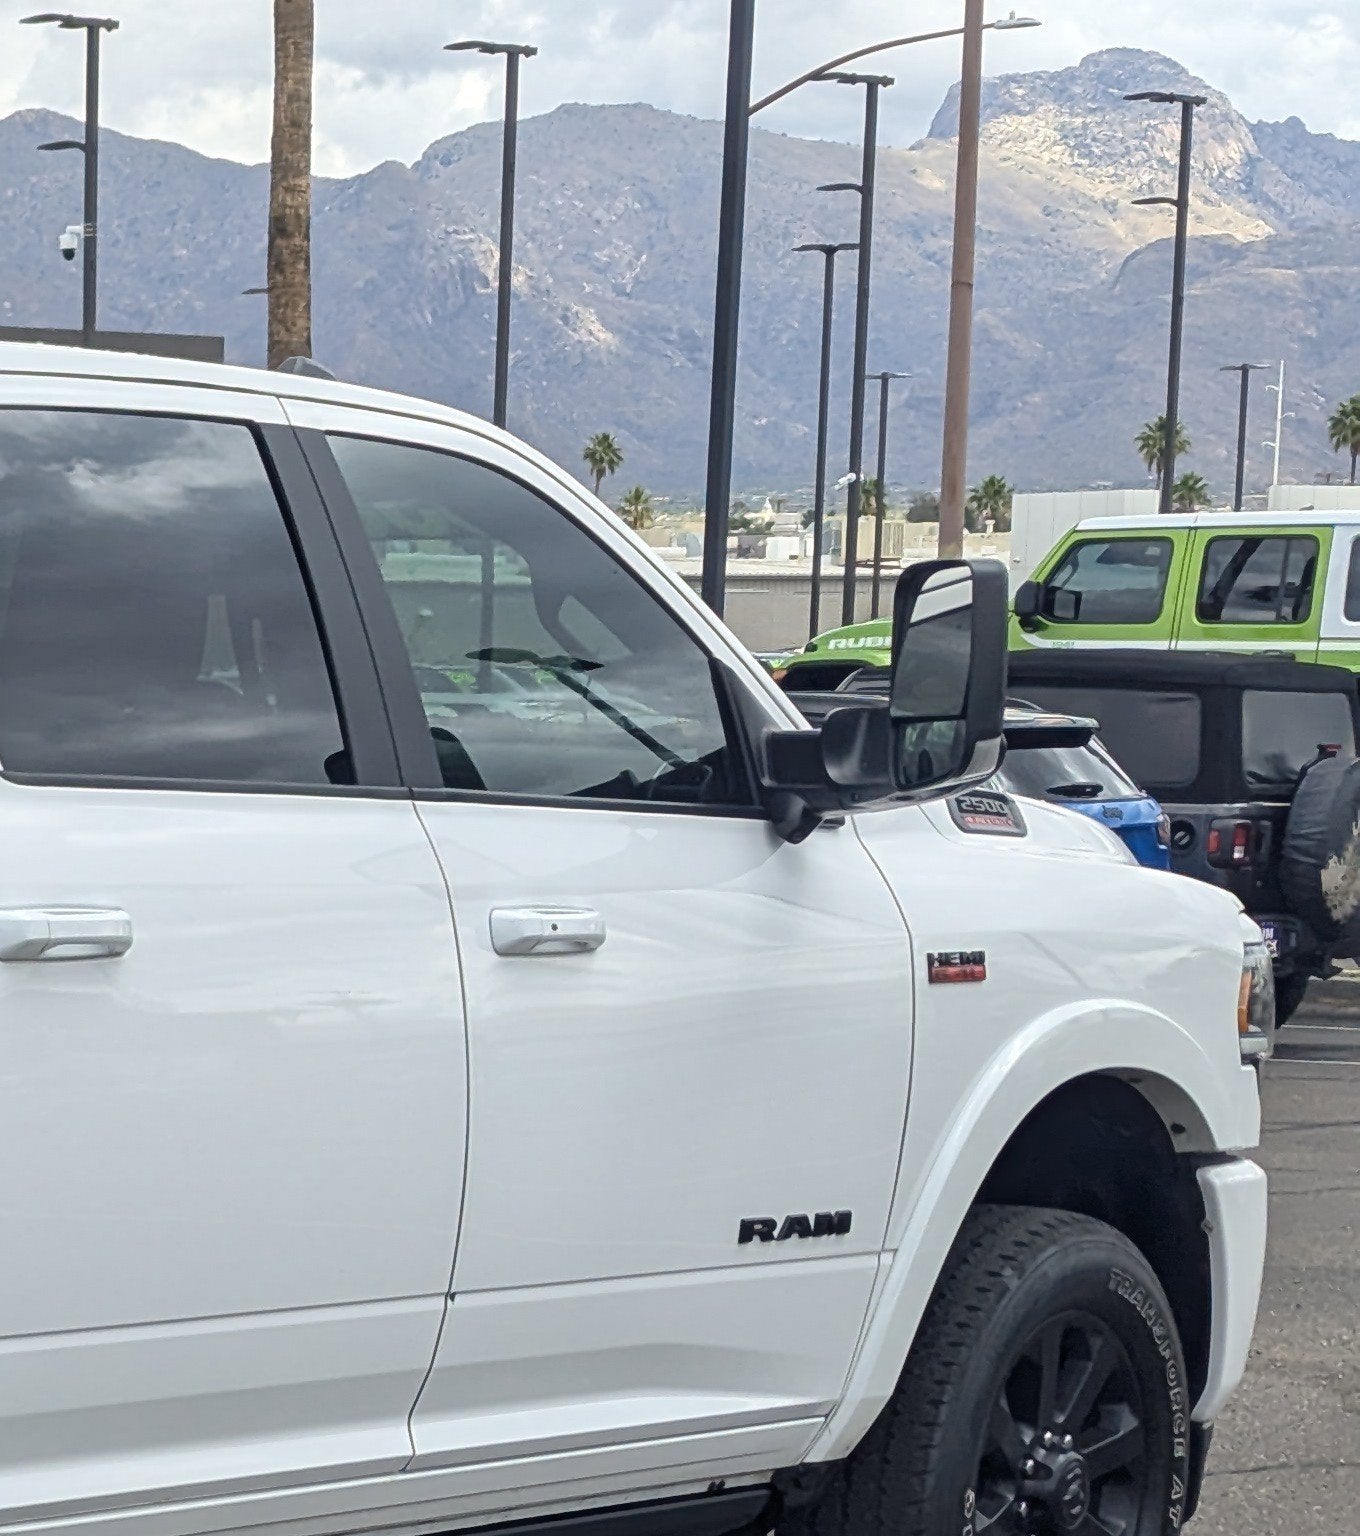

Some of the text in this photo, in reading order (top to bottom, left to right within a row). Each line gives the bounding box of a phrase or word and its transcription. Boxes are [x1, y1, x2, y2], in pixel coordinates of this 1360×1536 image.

[828, 635, 892, 650] RUBI
[960, 796, 1008, 816] 2500
[926, 951, 986, 968] HEMI
[737, 1209, 853, 1245] RAM
